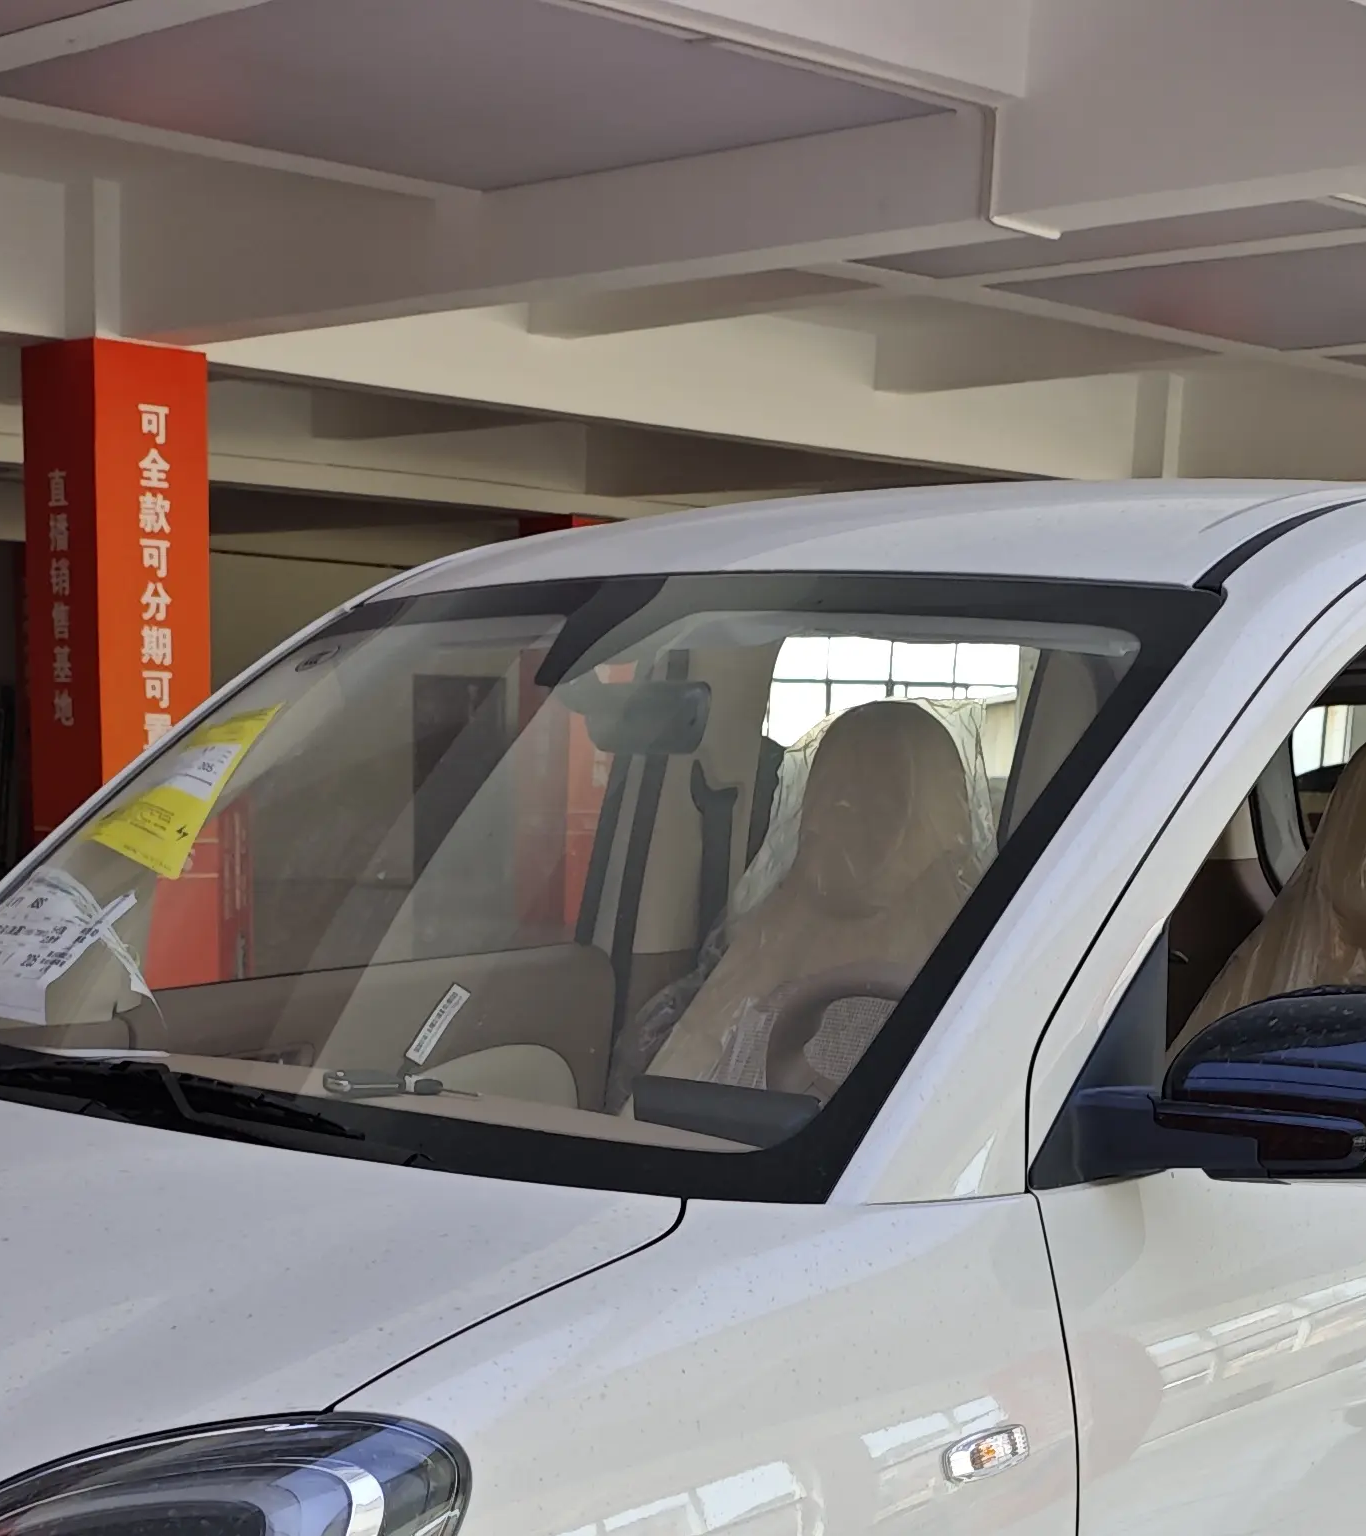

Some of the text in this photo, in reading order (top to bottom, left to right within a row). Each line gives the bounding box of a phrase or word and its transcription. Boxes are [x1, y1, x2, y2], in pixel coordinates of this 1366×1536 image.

[47, 467, 75, 728] 直播销售基地
